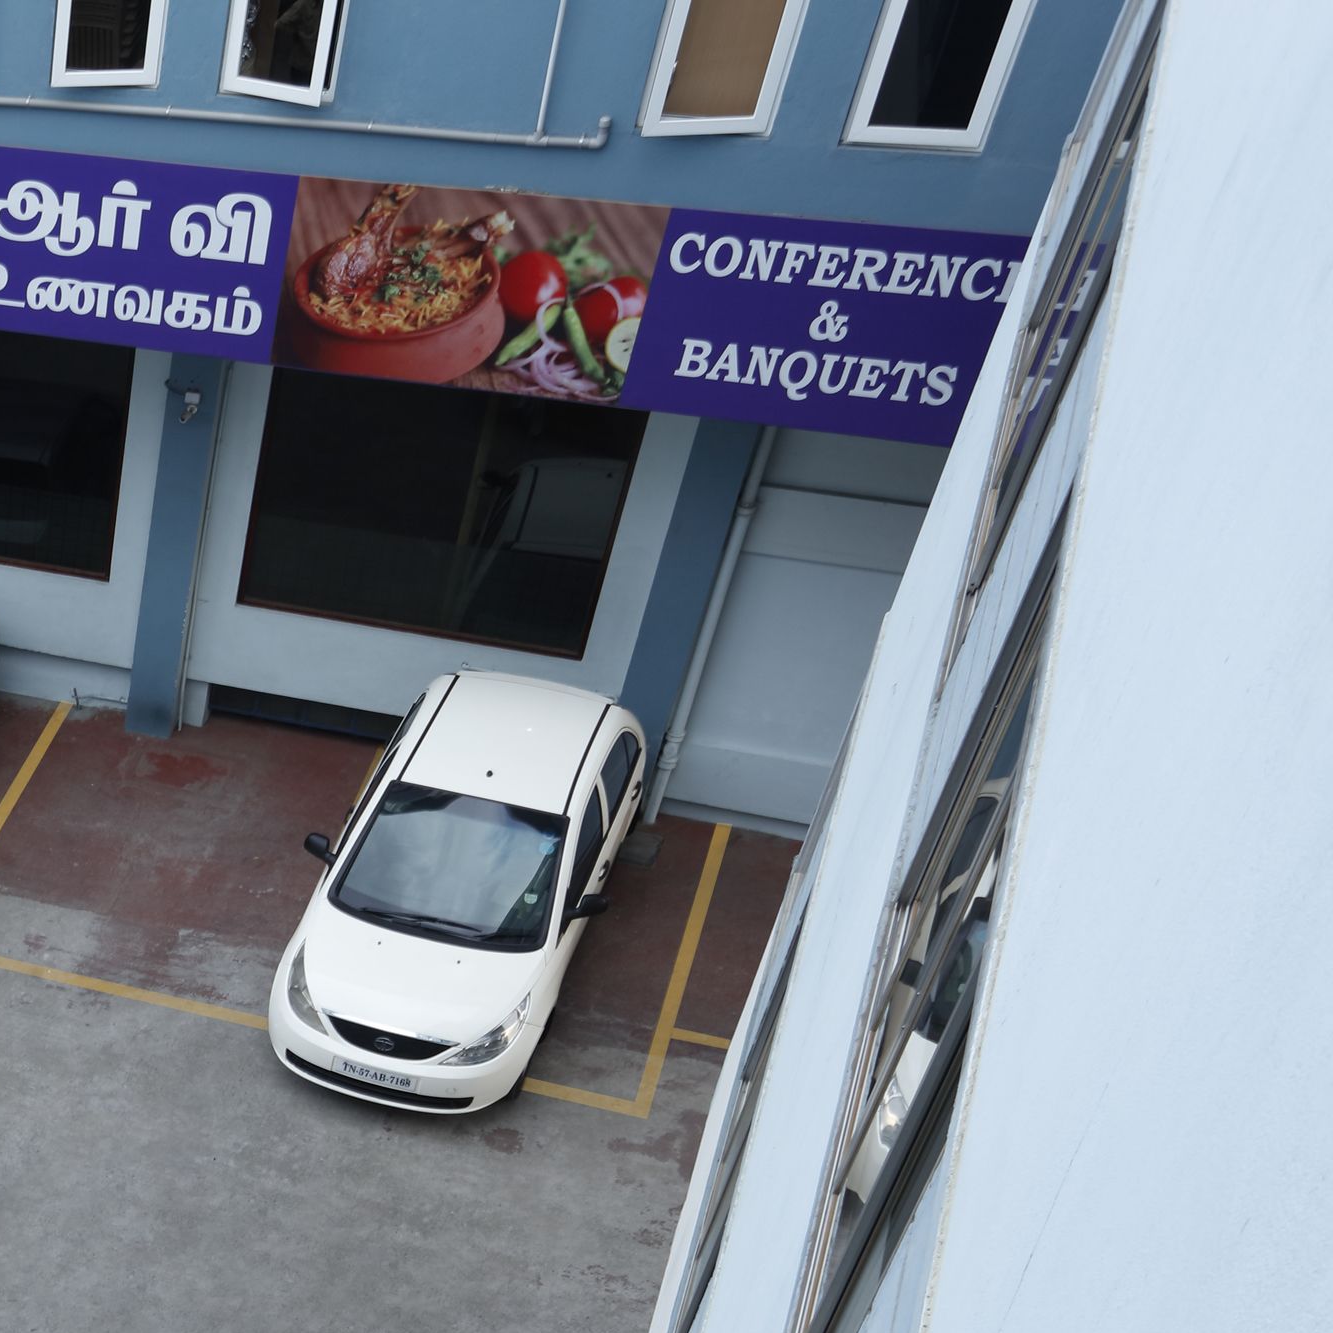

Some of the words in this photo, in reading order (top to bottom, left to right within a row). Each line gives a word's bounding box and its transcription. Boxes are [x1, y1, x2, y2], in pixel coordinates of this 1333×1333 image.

[168, 191, 274, 267] வி
[808, 300, 849, 343] &
[674, 338, 958, 408] BANQUETS
